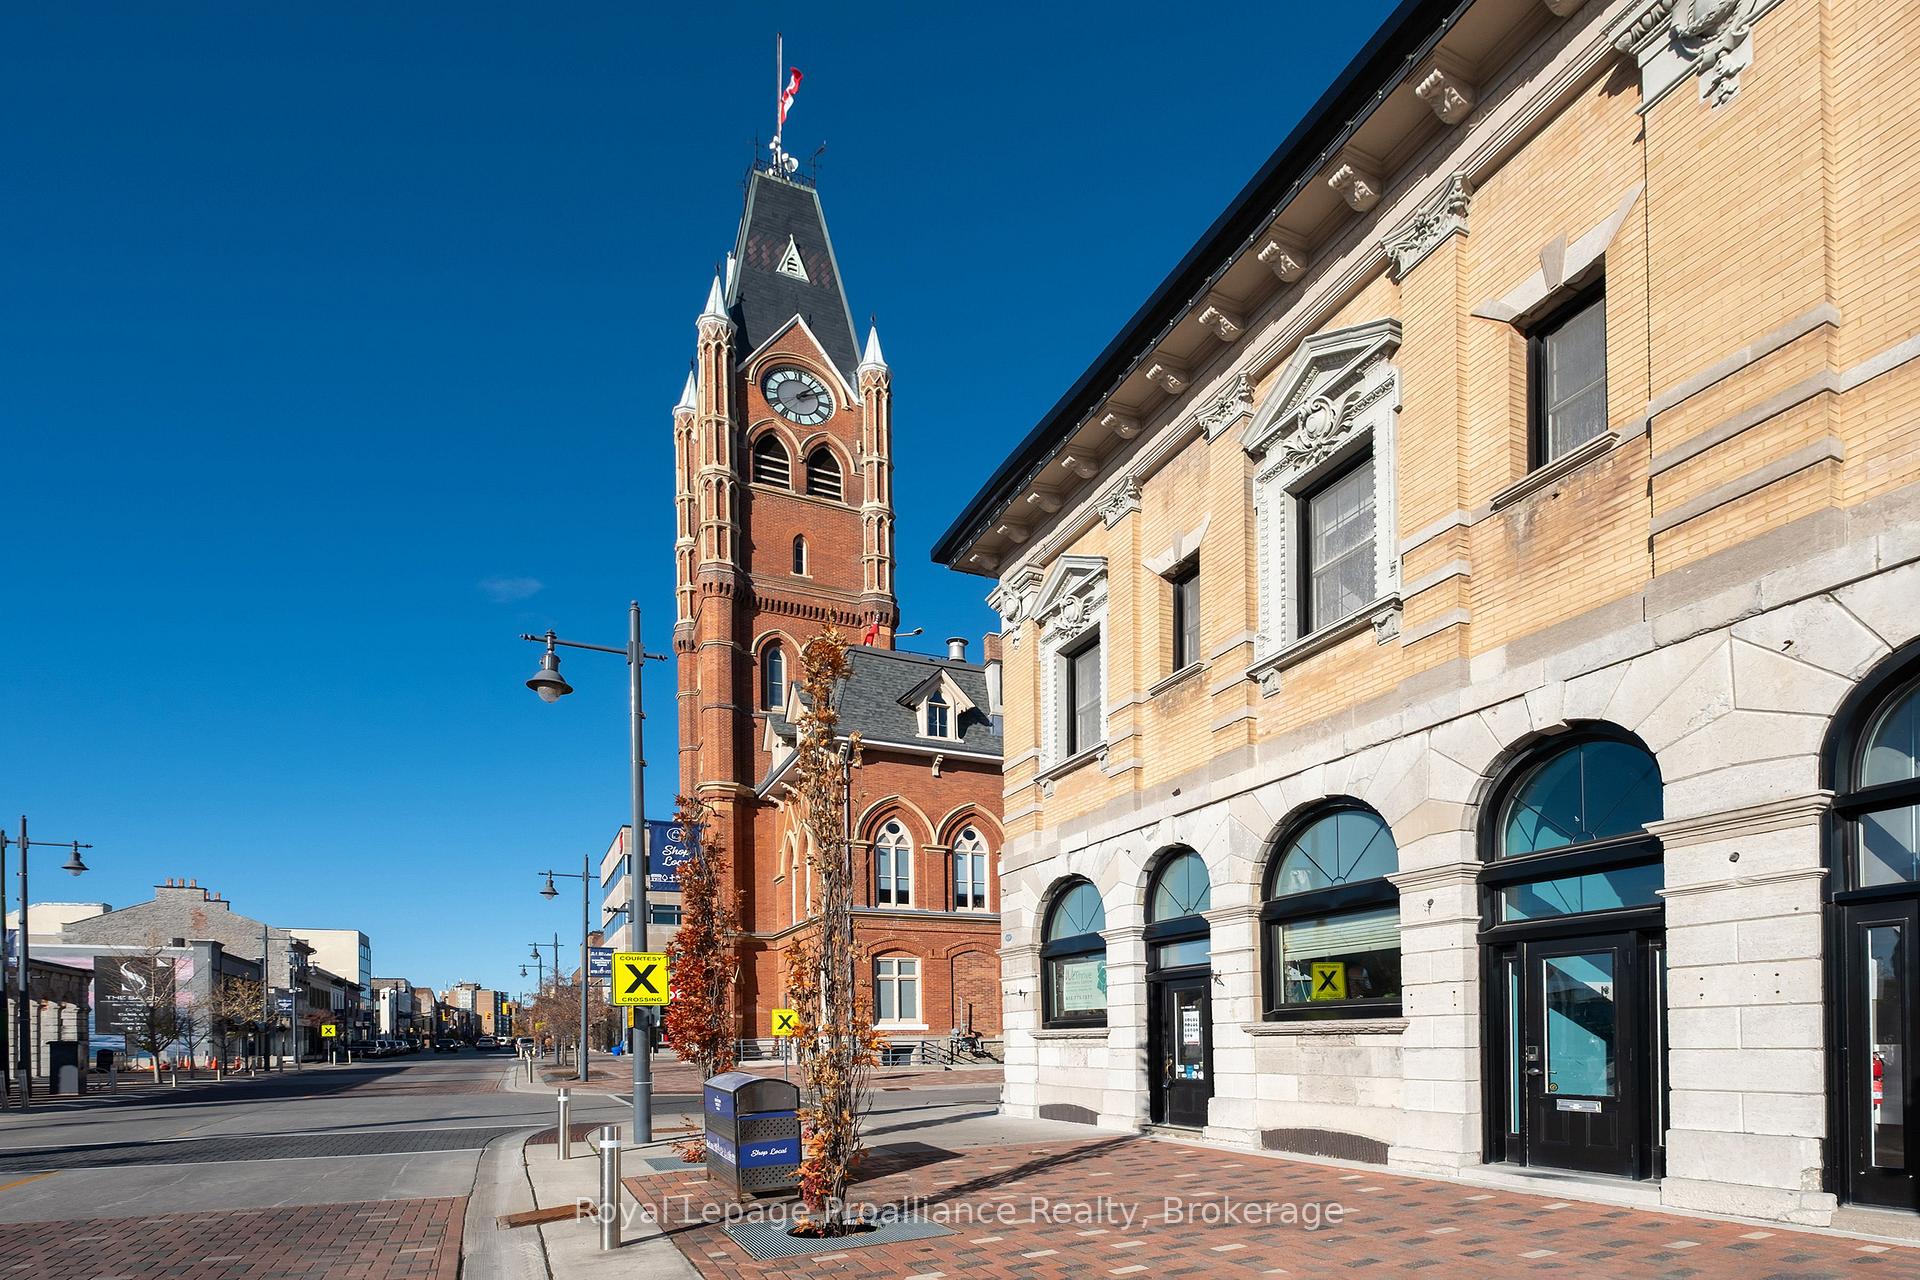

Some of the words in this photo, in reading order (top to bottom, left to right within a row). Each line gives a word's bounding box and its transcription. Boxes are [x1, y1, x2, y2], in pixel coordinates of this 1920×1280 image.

[661, 845, 691, 858] Shop
[624, 964, 660, 994] X
[1317, 970, 1339, 992] X
[777, 1014, 794, 1030] X
[750, 1149, 769, 1158] Shop
[769, 1147, 788, 1155] Local
